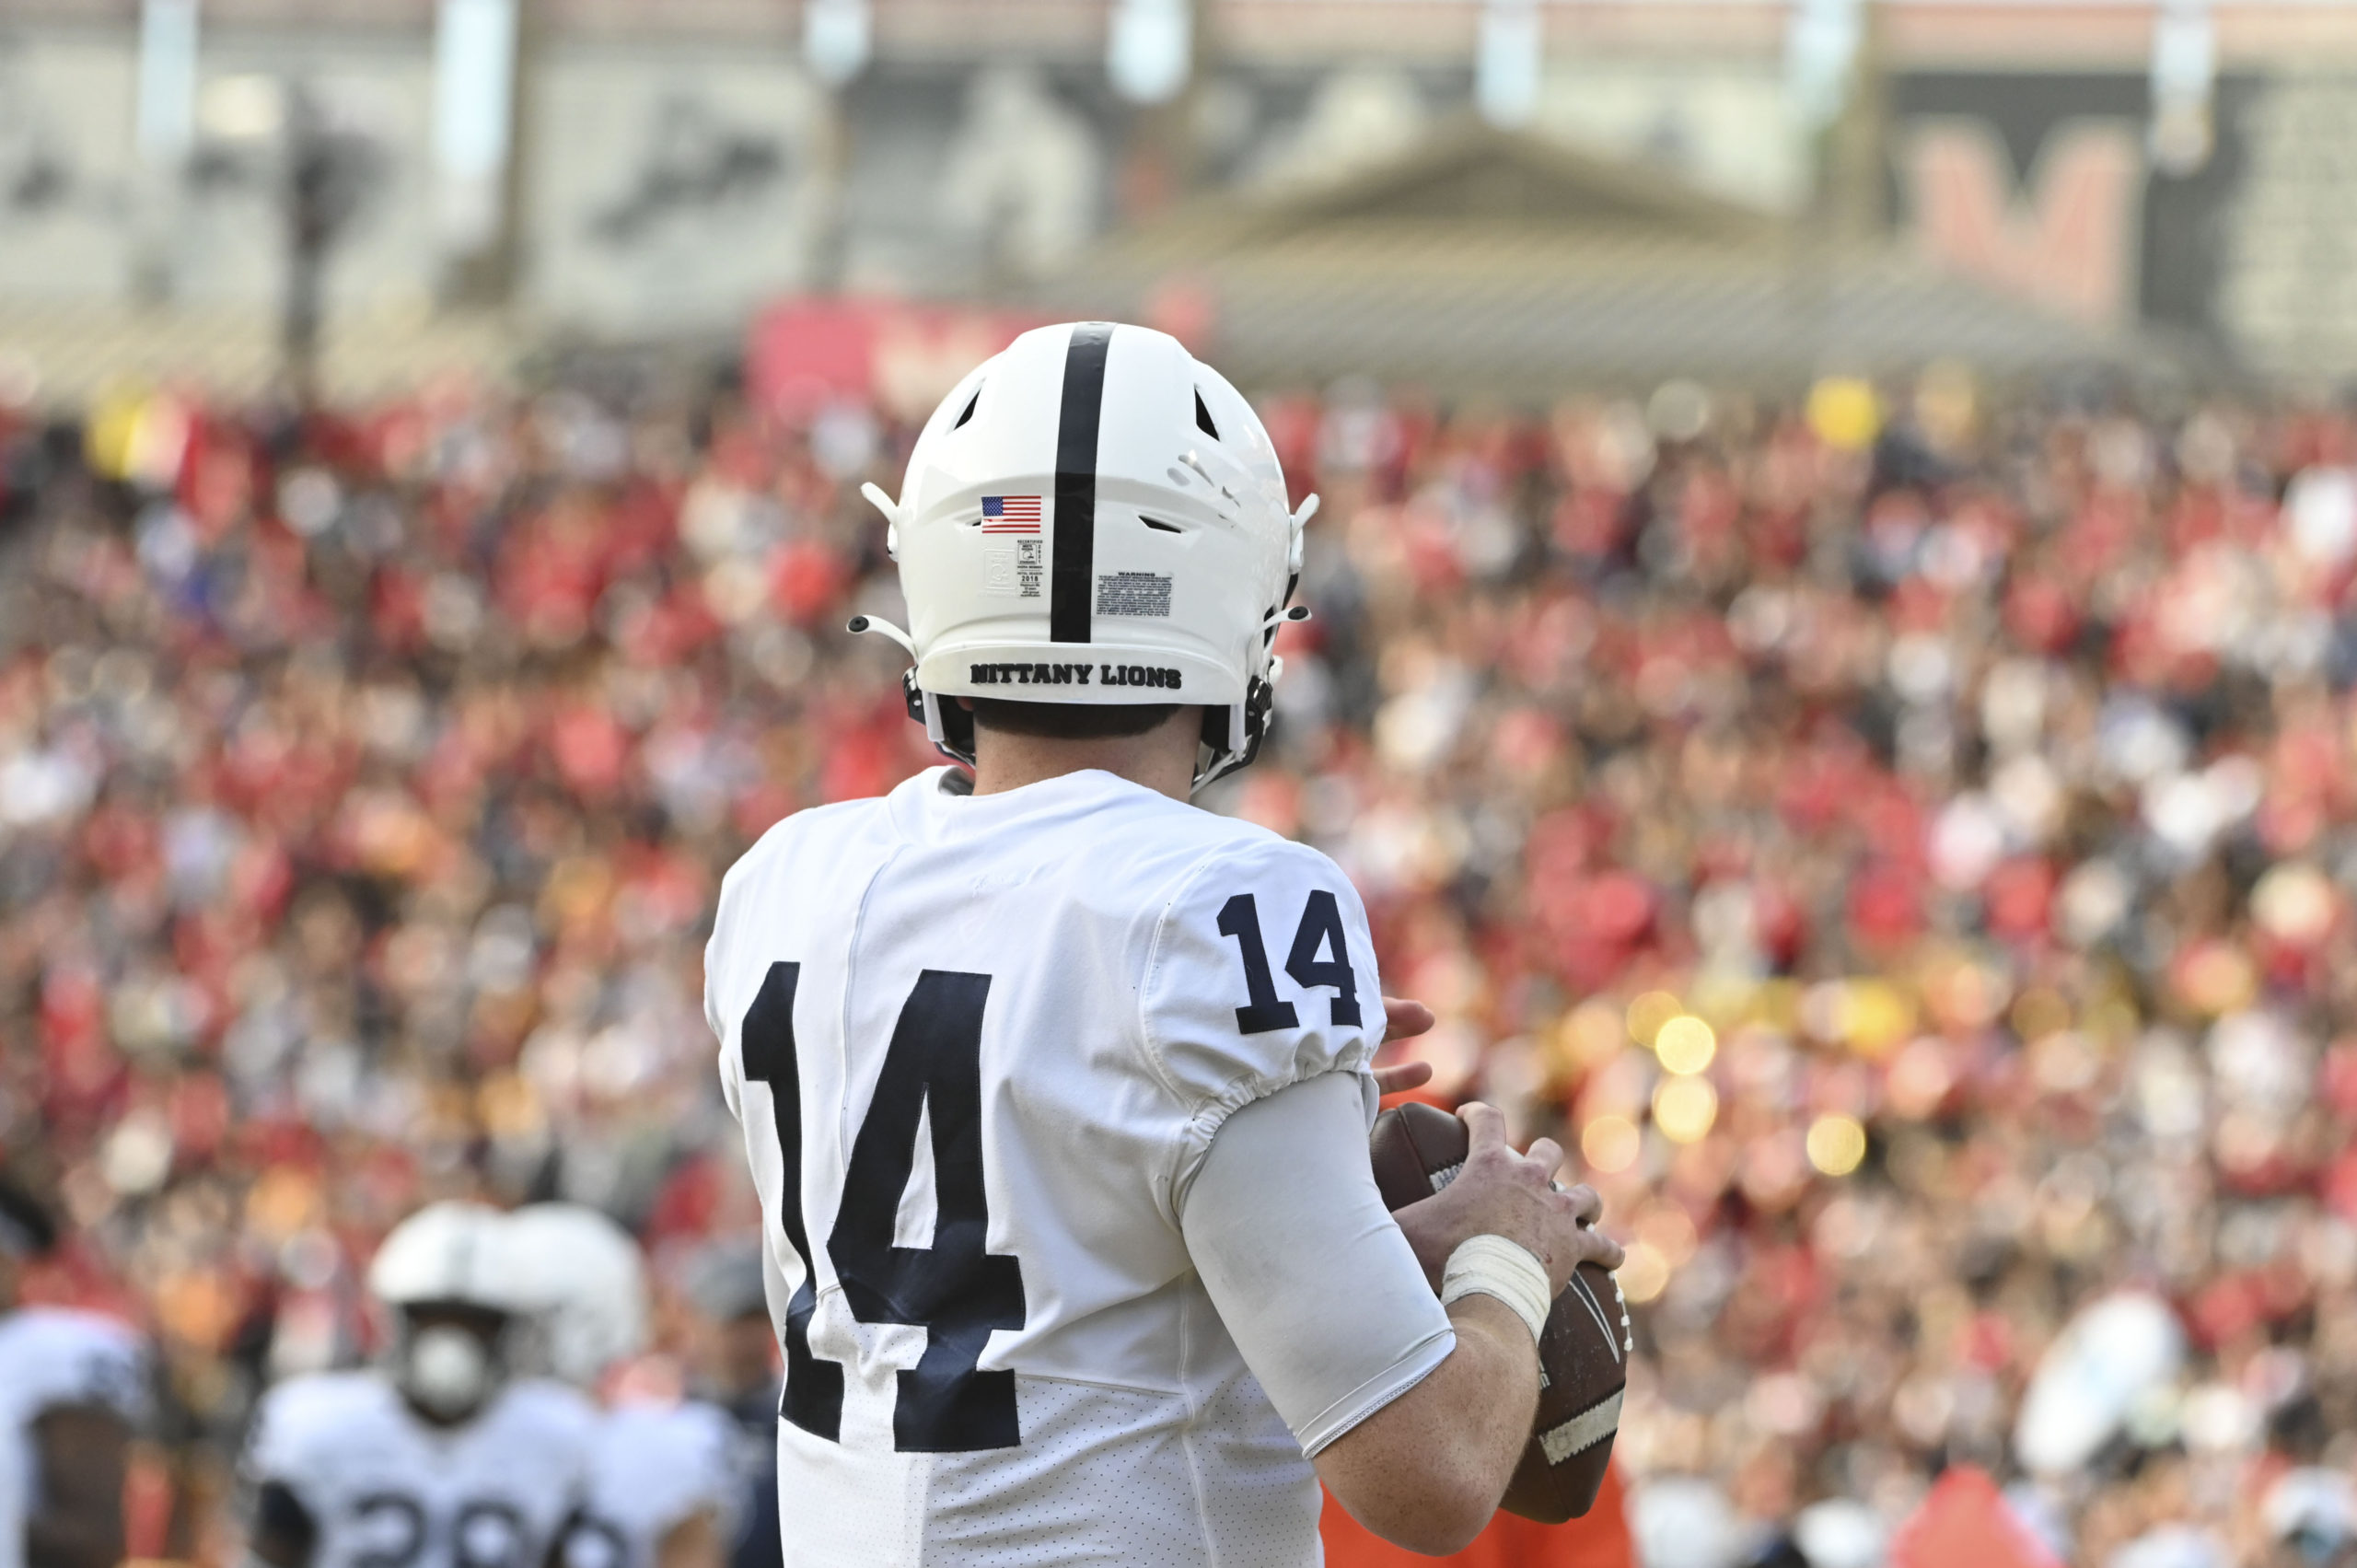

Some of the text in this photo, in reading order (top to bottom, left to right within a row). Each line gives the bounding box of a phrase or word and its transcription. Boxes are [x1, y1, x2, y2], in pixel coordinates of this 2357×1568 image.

[970, 663, 1182, 689] NITTANY LIONS
[1216, 889, 1363, 1034] 14
[741, 961, 1026, 1452] 14
